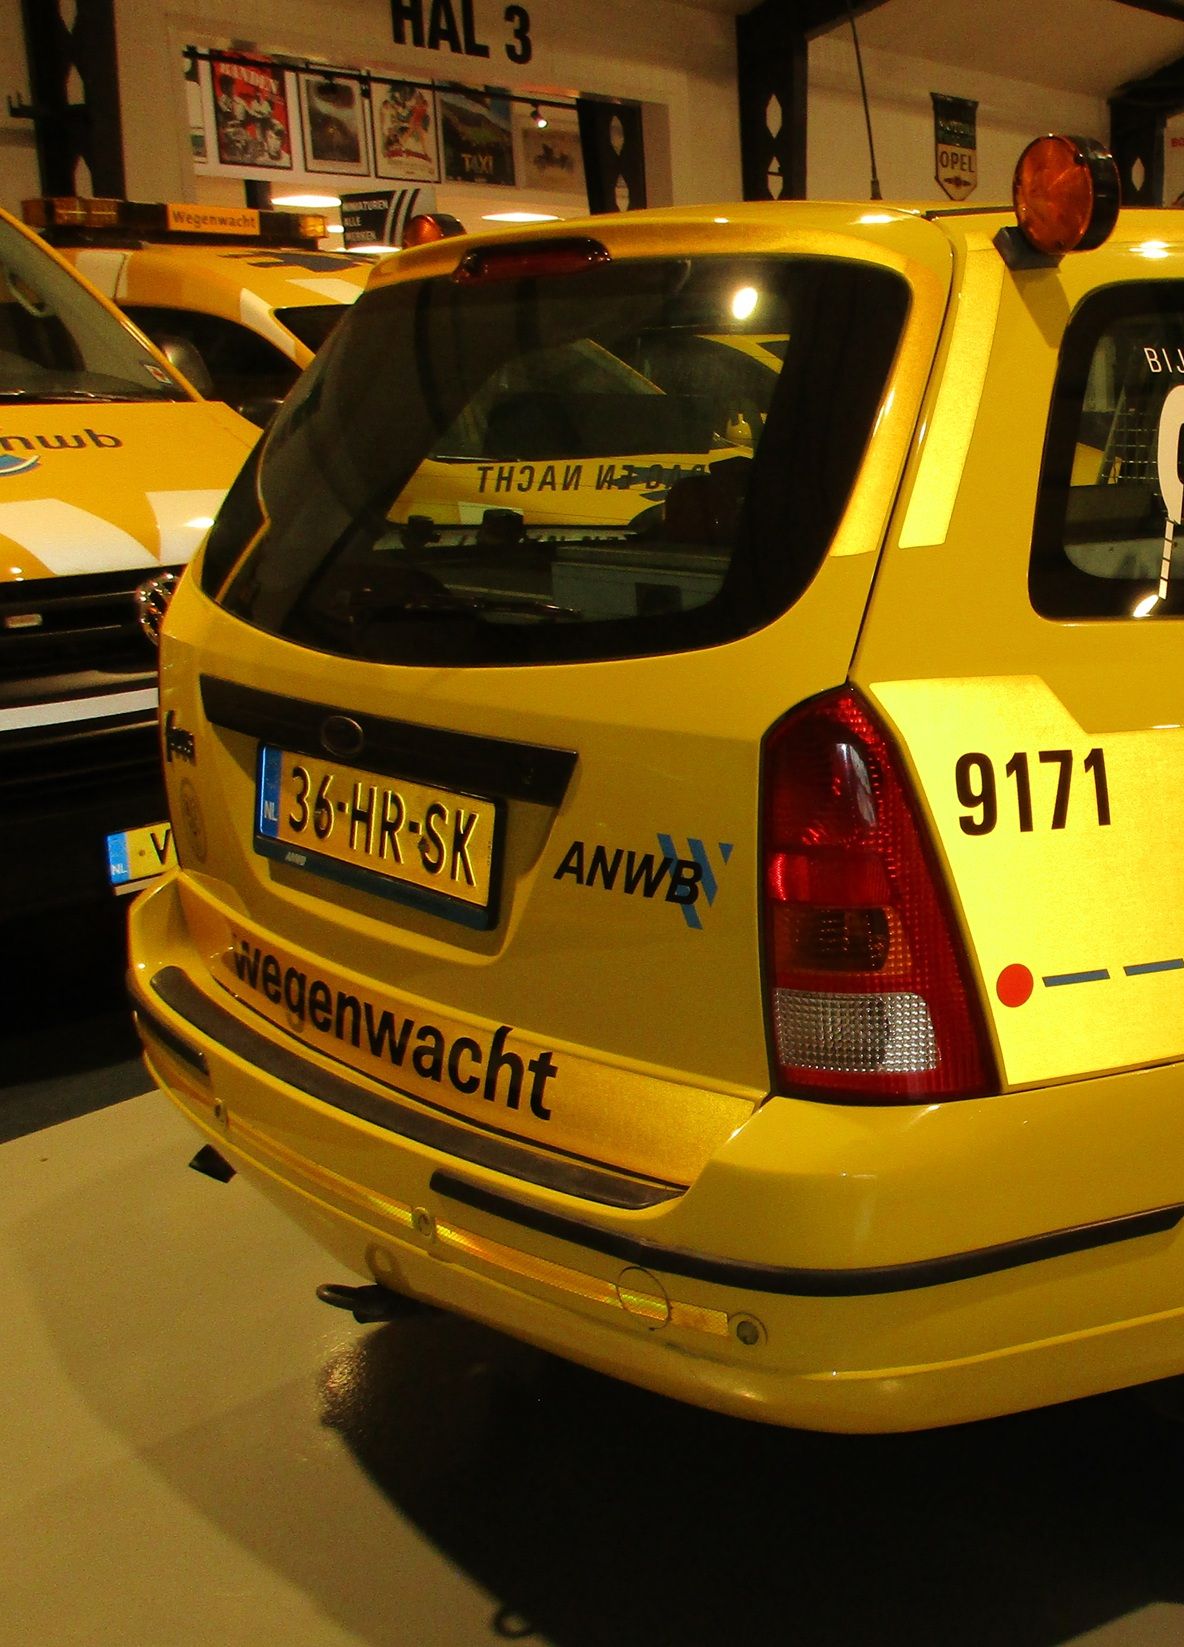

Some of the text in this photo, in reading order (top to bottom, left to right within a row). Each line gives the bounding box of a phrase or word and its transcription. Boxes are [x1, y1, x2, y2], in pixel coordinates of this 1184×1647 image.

[390, 0, 532, 64] HAL 3
[462, 153, 494, 174] TAXI
[940, 151, 975, 173] OPEL
[173, 209, 257, 229] Wegenwacht
[264, 800, 278, 822] NL
[955, 748, 1111, 836] 9171
[288, 767, 480, 887] 36-HR-SK
[111, 863, 128, 876] NL
[553, 841, 704, 905] ANWB
[233, 940, 558, 1121] wegenwacht
